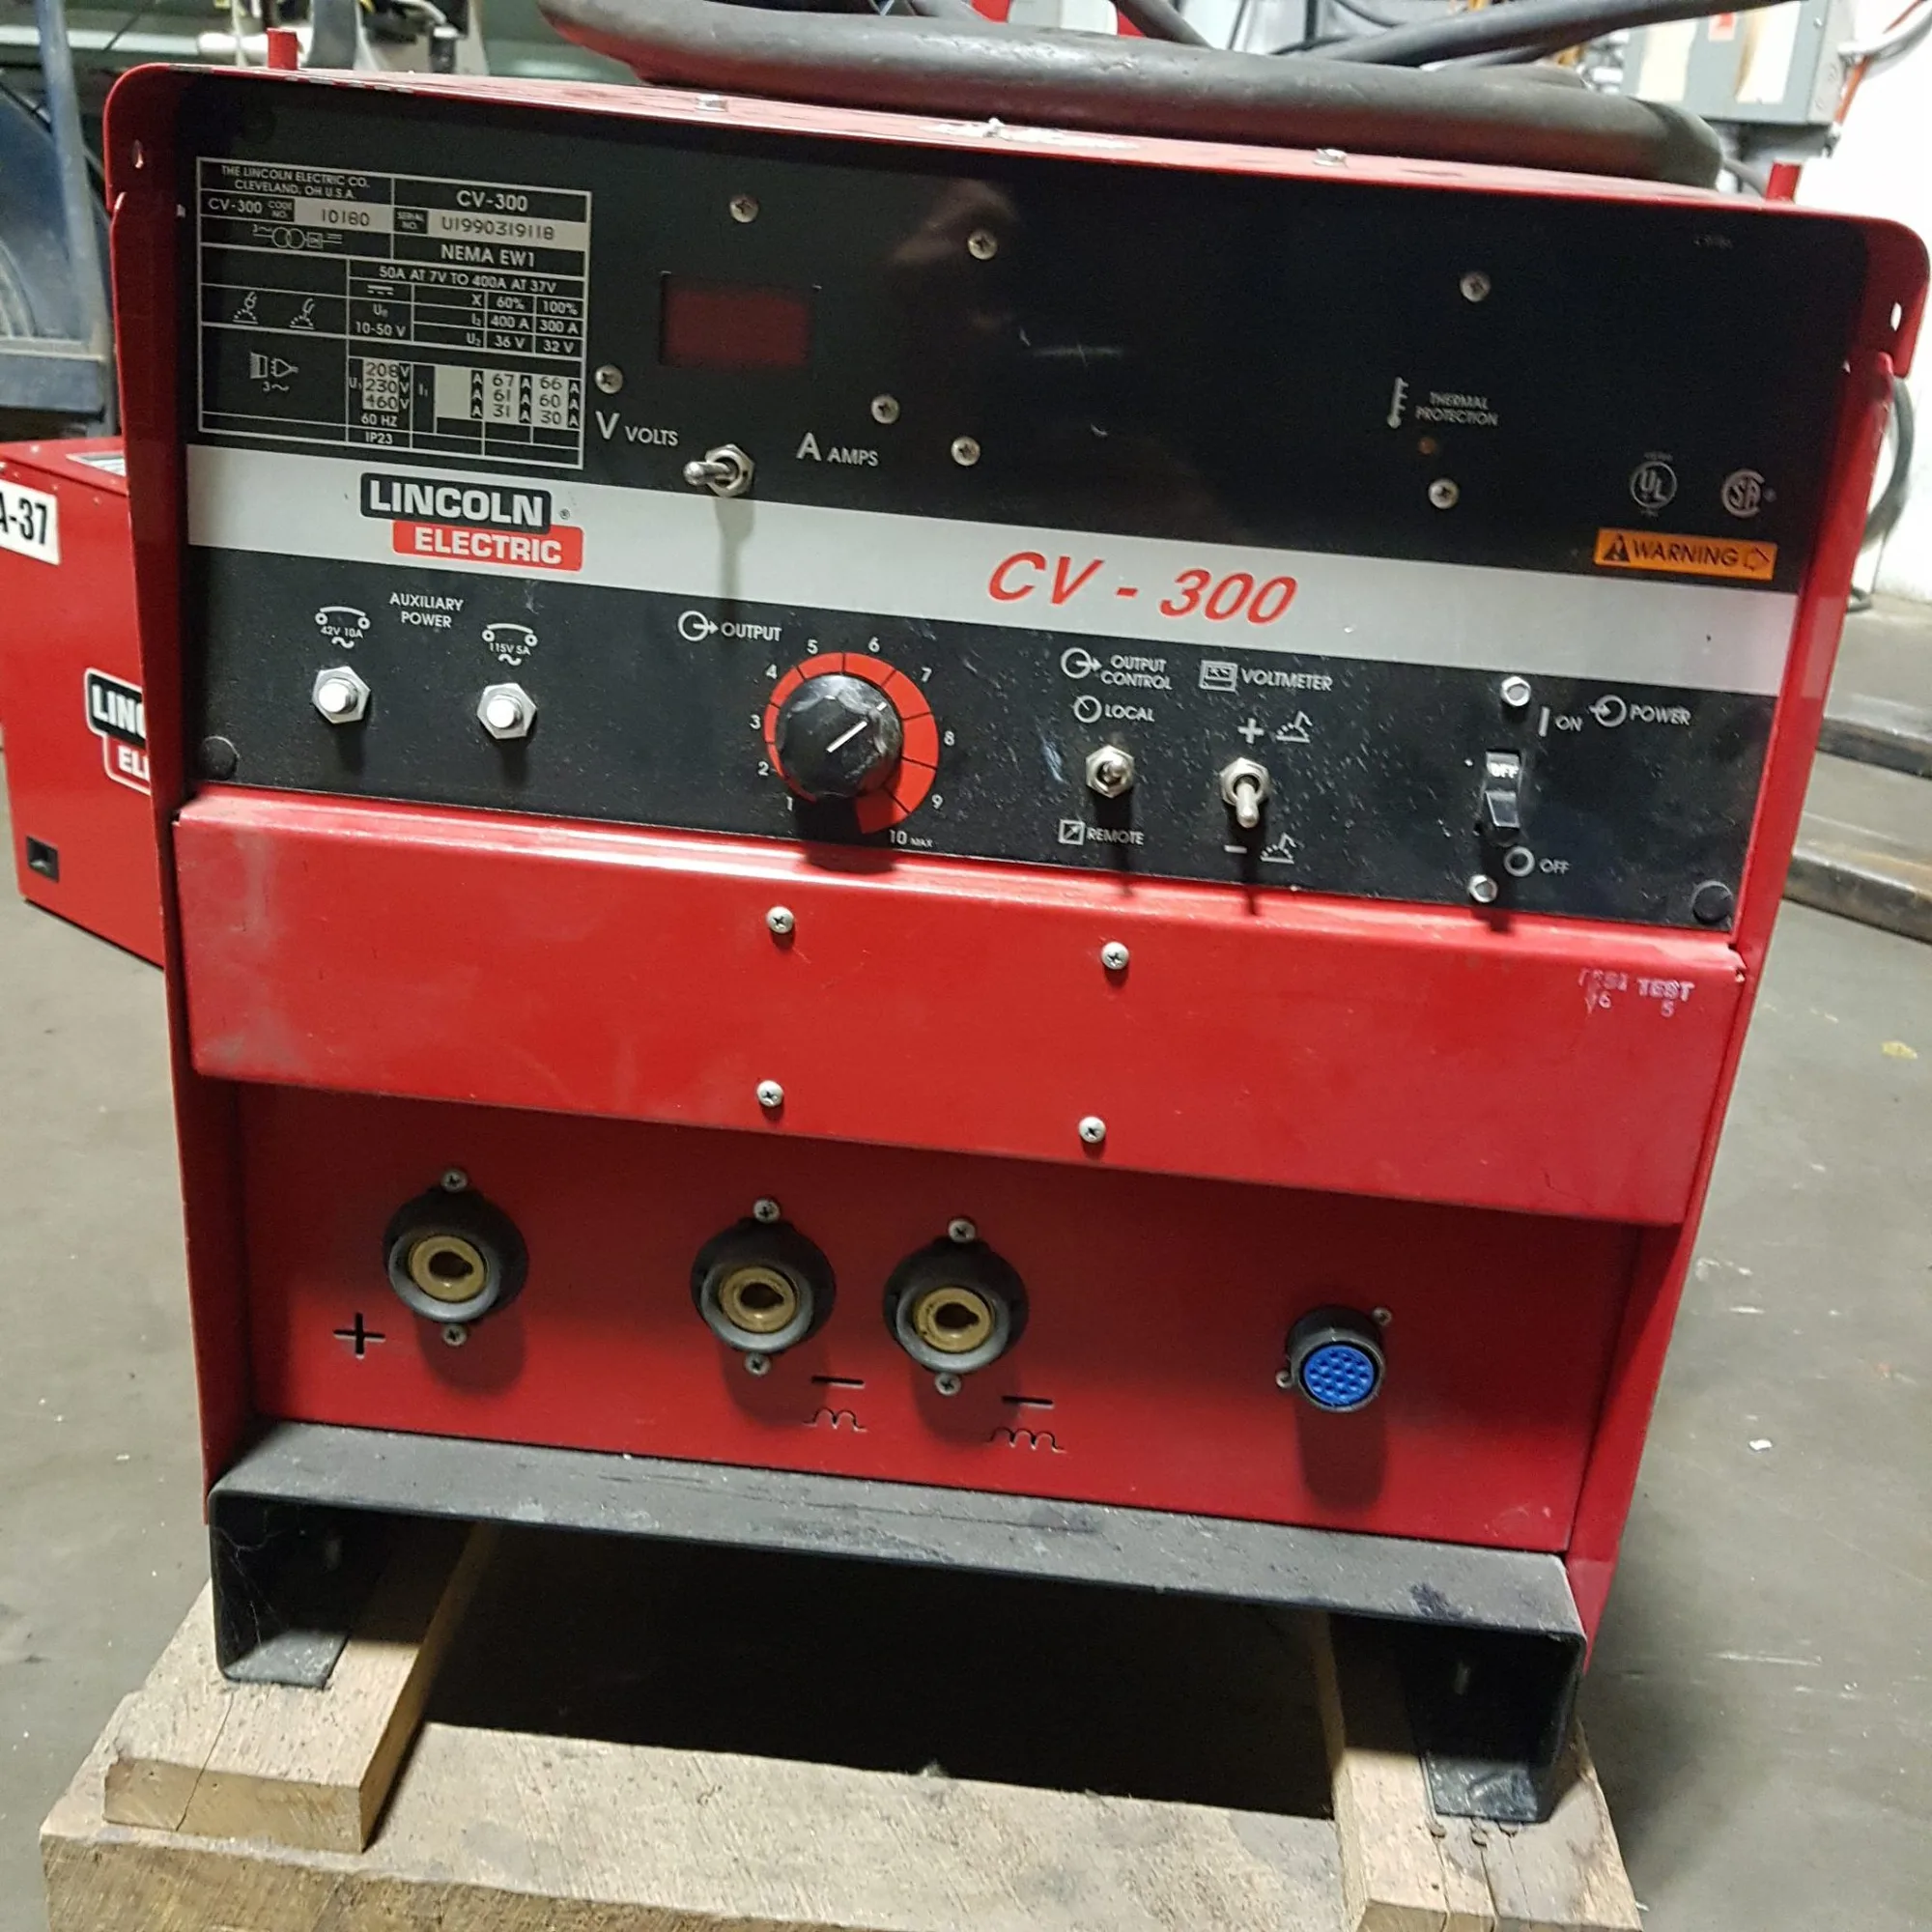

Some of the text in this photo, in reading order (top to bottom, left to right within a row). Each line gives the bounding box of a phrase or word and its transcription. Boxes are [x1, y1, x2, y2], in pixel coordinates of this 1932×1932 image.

[221, 165, 370, 187] THE LINCOLN ELECTRIC CO.
[304, 185, 322, 196] OH
[456, 189, 528, 212] CV-300
[208, 197, 263, 214] CV-300
[321, 208, 370, 227] 10180
[441, 215, 555, 241] U1990319118
[440, 243, 535, 268] NEMA EW1
[379, 266, 557, 294] 50A AT 7V TO 400A AT 37V
[496, 297, 526, 311] 60%
[542, 299, 579, 315] 100%
[355, 321, 407, 338] 10-50 V
[491, 318, 516, 328] 400
[519, 318, 530, 330] A
[539, 321, 565, 333] 300
[567, 323, 579, 334] A
[494, 335, 510, 348] 36
[513, 337, 526, 350] V
[543, 339, 560, 353] 32
[563, 342, 575, 355] V
[472, 372, 580, 394] A 67 A 66 A
[472, 388, 580, 411] A 61 A 60 A
[1430, 391, 1489, 411] THERMAL
[361, 412, 398, 427] 60 HZ
[471, 404, 580, 427] A 31 A 30 A
[1415, 405, 1499, 426] PROTECTION
[365, 431, 393, 444] IP23
[595, 410, 679, 447] V VOLTS
[796, 431, 879, 468] A AMPS
[370, 480, 543, 527] LINCOLN
[0, 490, 47, 546] A-37
[414, 526, 562, 565] ELECTRIC
[1633, 538, 1739, 567] WARNING
[987, 551, 1104, 605] CV
[1158, 568, 1298, 626] 300
[389, 592, 464, 611] AUXILIARY
[400, 611, 452, 629] POWER
[721, 622, 782, 642] OUTPUT
[489, 641, 513, 654] 115V
[808, 639, 819, 655] 5
[868, 637, 880, 654] 6
[766, 663, 778, 680] 4
[1111, 654, 1168, 674] OUTPUT
[920, 667, 932, 683] 7
[1100, 670, 1173, 691] CONTROL
[1240, 668, 1333, 693] VOLTMETER
[750, 714, 762, 730] 3
[1104, 703, 1155, 723] LOCAL
[1555, 715, 1582, 731] ON
[1630, 703, 1691, 726] POWER
[944, 729, 956, 747] 8
[757, 760, 770, 777] 2
[785, 796, 793, 811] 1
[931, 792, 944, 810] 9
[889, 829, 908, 845] 10
[1087, 828, 1145, 846] REMOTE
[1539, 859, 1571, 875] OFF
[1637, 977, 1695, 1002] TEST
